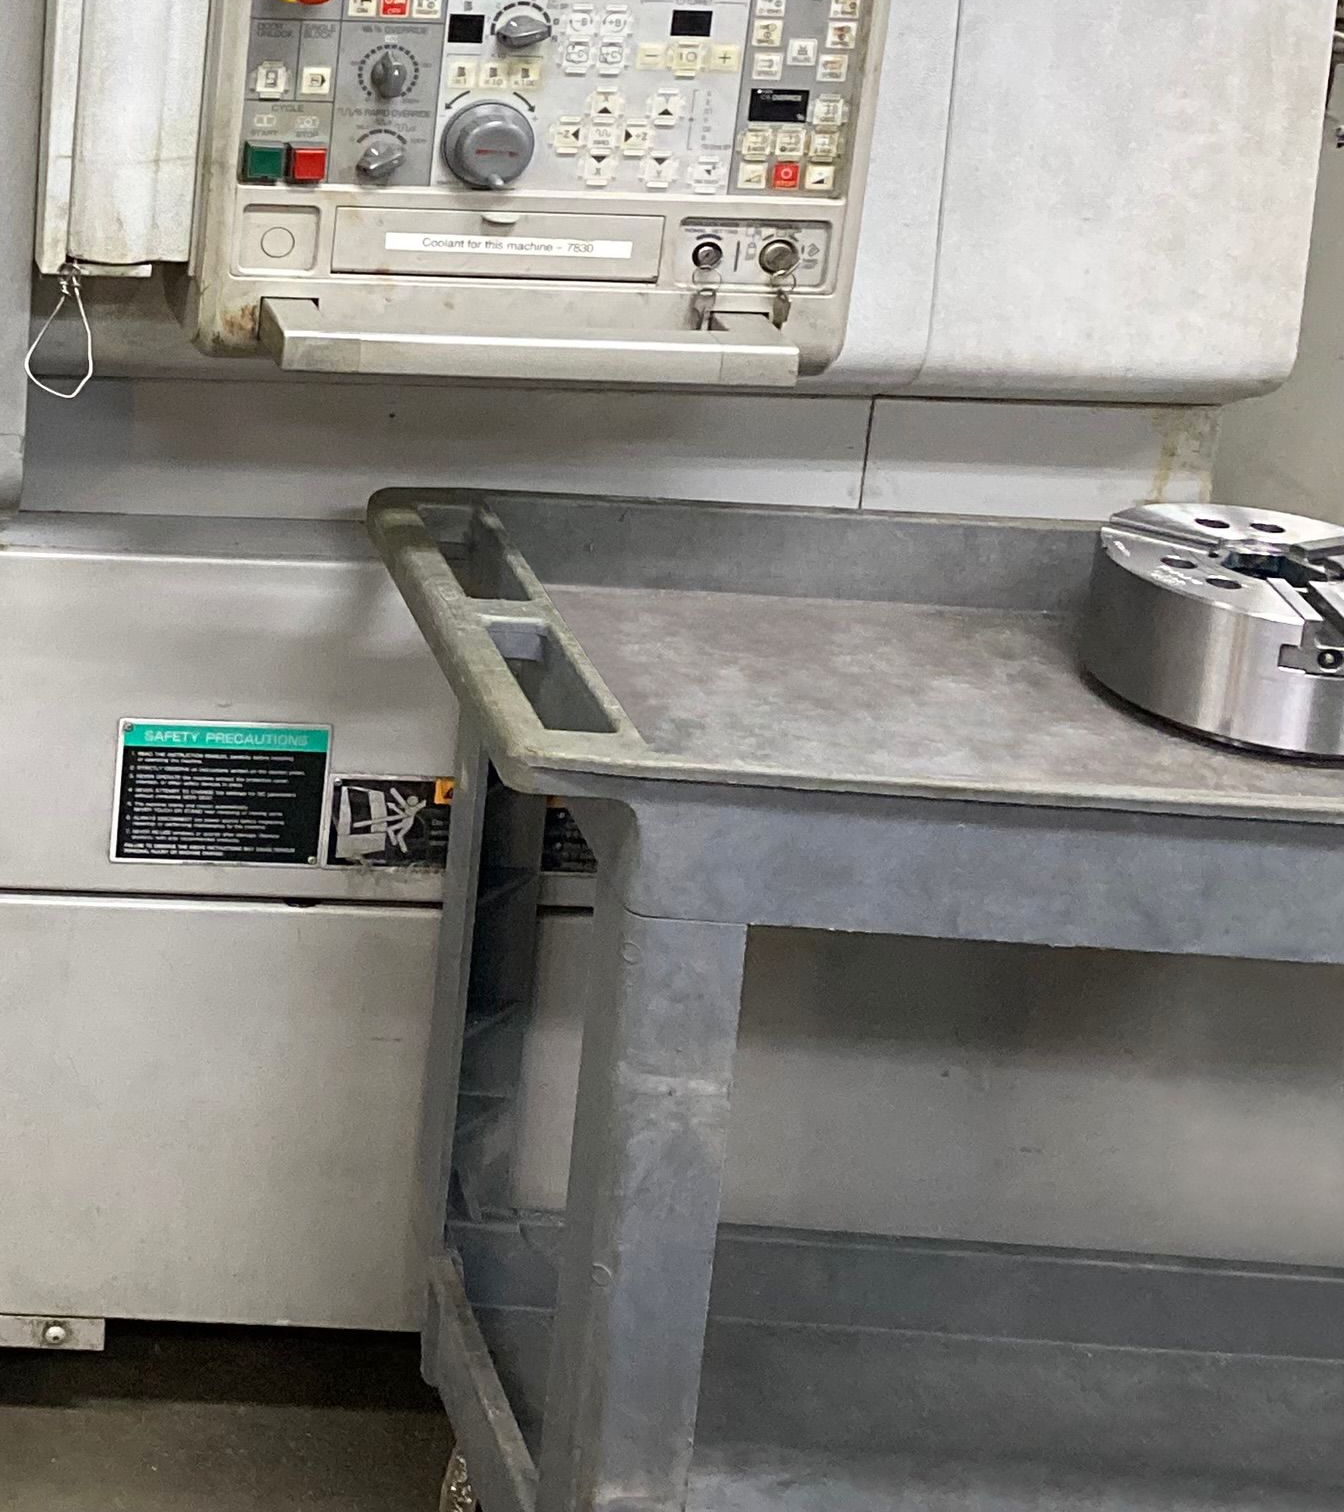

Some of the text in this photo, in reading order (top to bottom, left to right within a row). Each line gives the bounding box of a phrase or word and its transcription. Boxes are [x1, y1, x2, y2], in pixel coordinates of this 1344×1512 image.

[271, 104, 304, 112] CYCLE
[422, 236, 465, 248] Coolant
[467, 239, 482, 249] for
[485, 239, 504, 250] this
[506, 241, 553, 252] machine
[566, 243, 594, 253] 7830
[144, 730, 308, 746] SAFETY PRECAUTIONS
